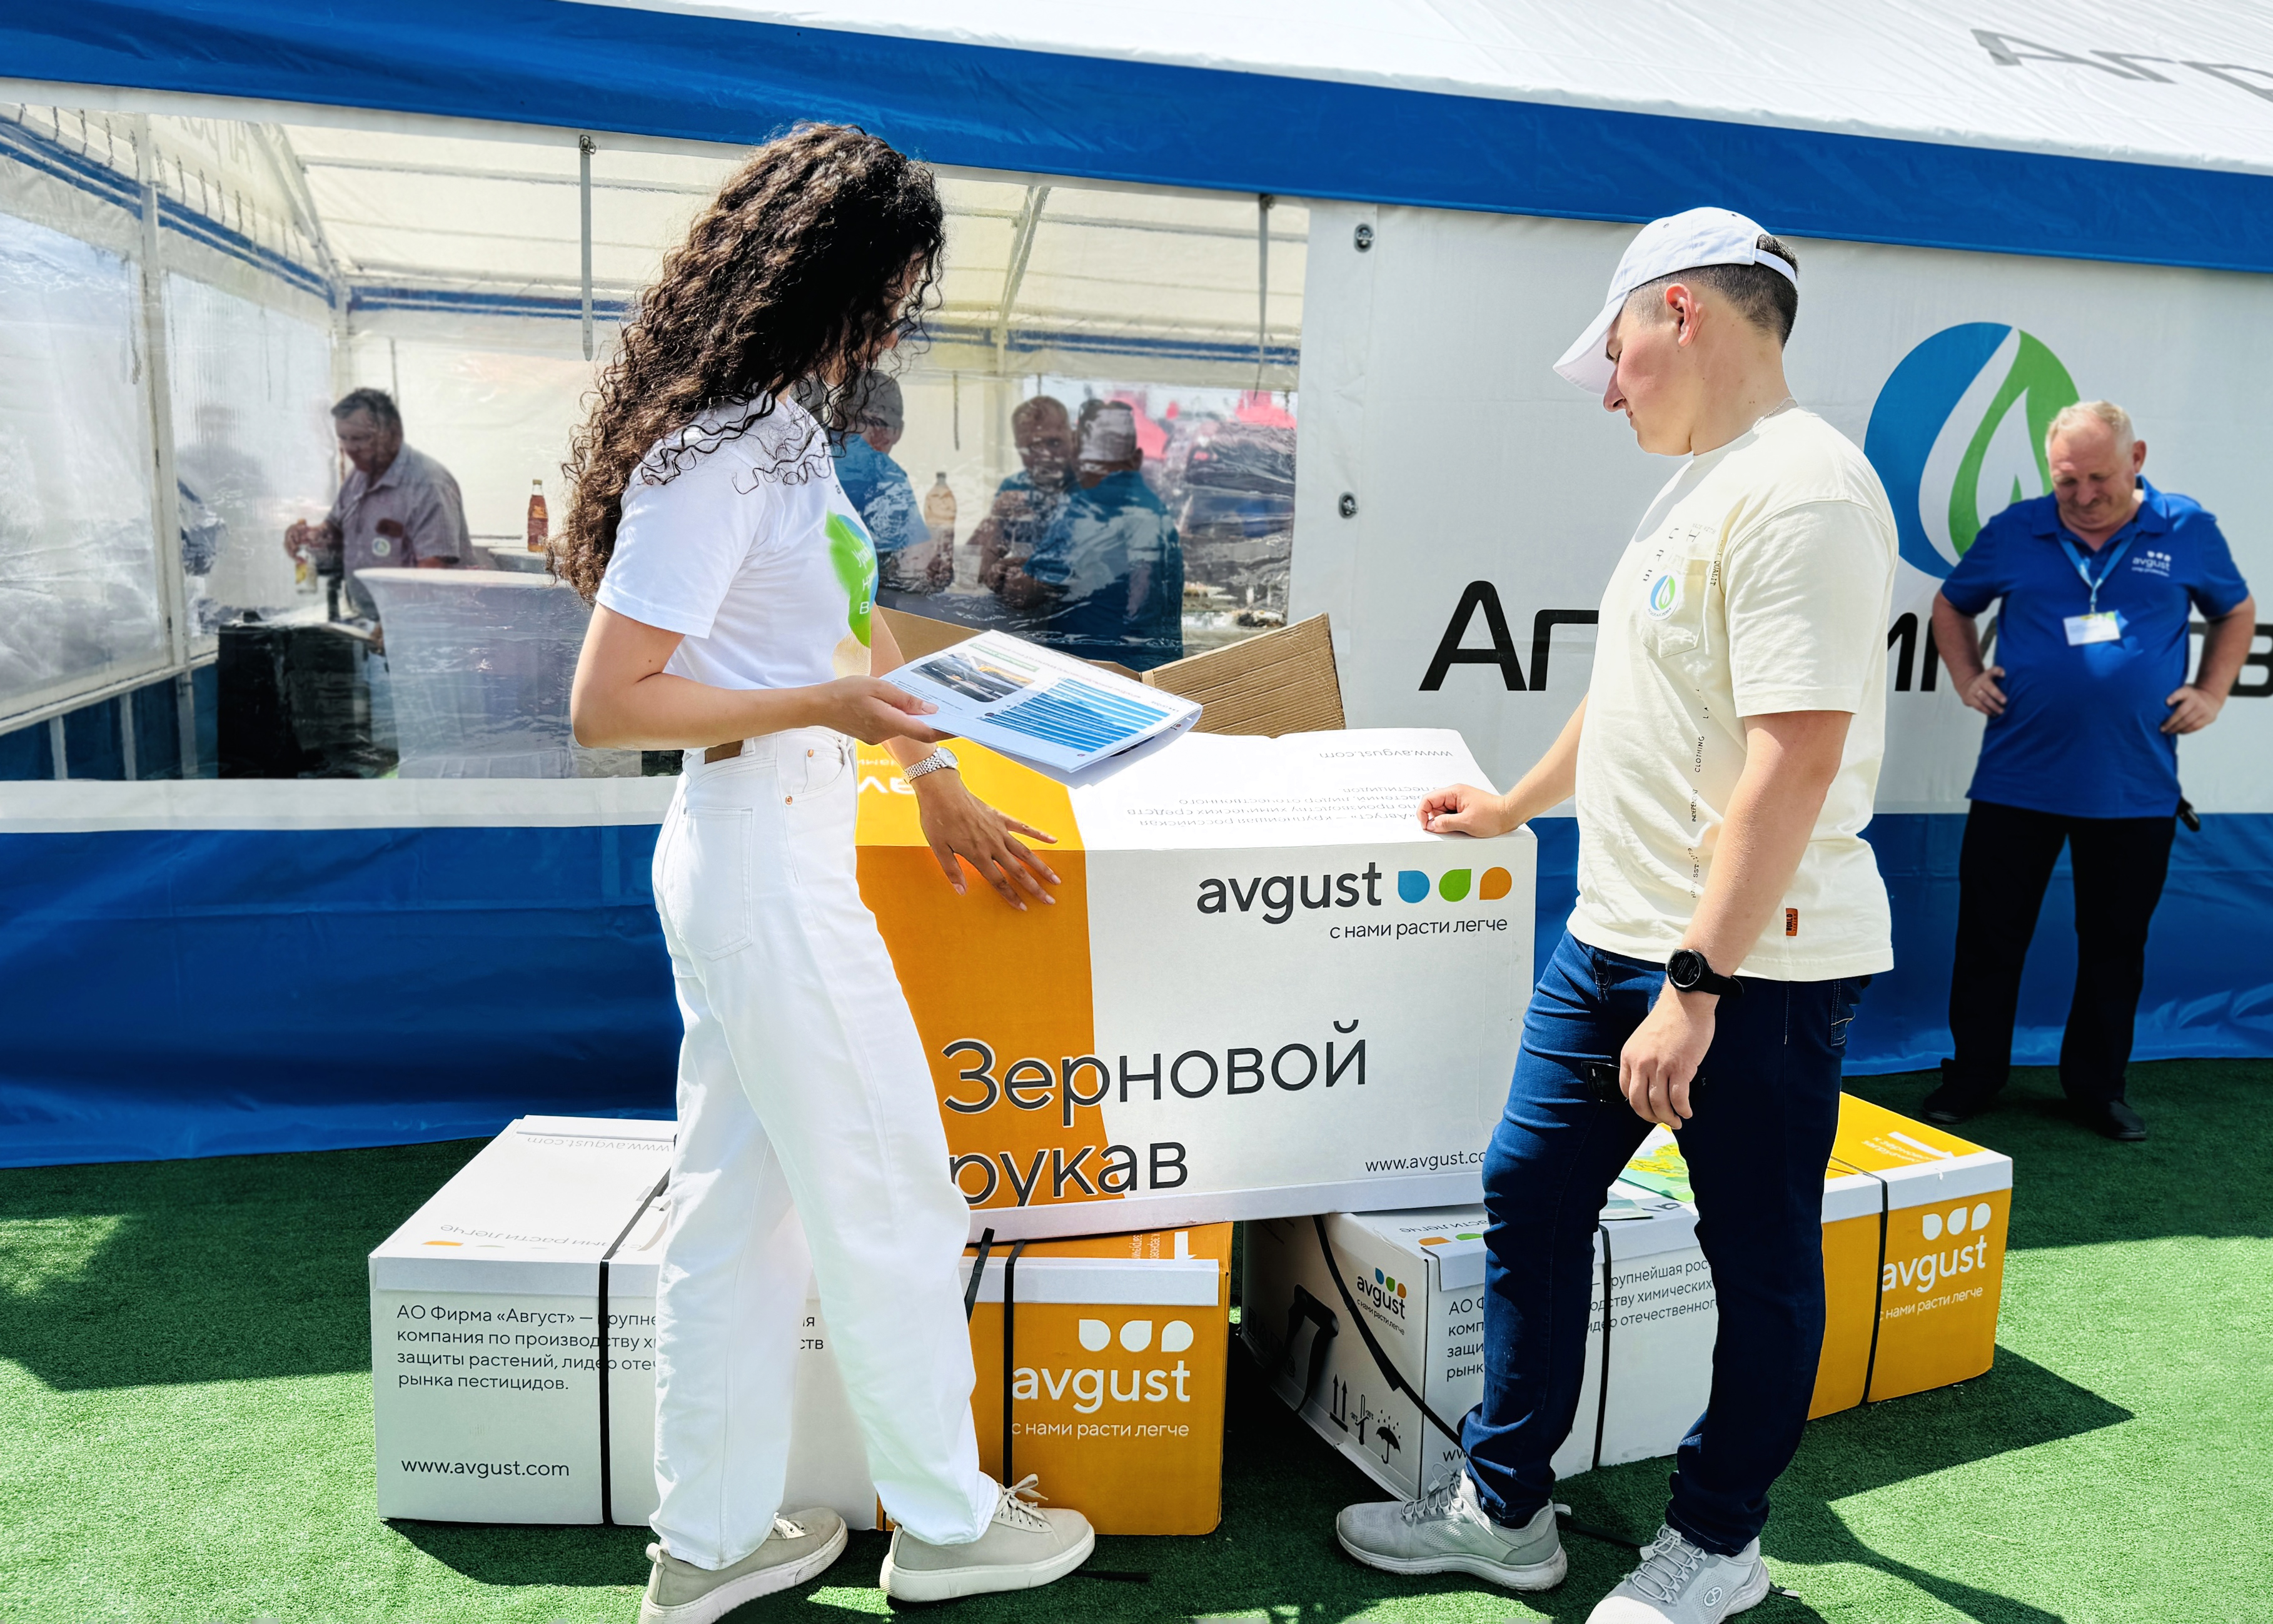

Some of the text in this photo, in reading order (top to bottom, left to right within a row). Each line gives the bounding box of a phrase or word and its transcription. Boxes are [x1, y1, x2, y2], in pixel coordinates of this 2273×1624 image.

[2132, 557, 2170, 572] avgust
[1319, 749, 1453, 759] www.avgust.com
[1695, 736, 1705, 772] CLOTHING
[1197, 862, 1382, 924] avgust
[1329, 918, 1508, 939] с нами расти легче
[942, 1019, 1366, 1127] Зерновой
[527, 1137, 670, 1152] www.avgust.com
[1366, 1151, 1486, 1173] www.avgust.co
[949, 1141, 1188, 1207] рукав
[440, 1224, 505, 1239] легче
[1399, 1219, 1489, 1233] асти легче
[505, 1235, 569, 1246] расти
[1882, 1235, 1987, 1293] avgust
[1611, 1266, 1682, 1290] рупнейшая
[1357, 1276, 1405, 1319] avgust
[1637, 1279, 1713, 1303] химических
[1449, 1299, 1473, 1315] АО
[1621, 1299, 1715, 1326] отечественног
[1885, 1303, 1915, 1319] нами
[1917, 1294, 1950, 1314] расти
[1952, 1287, 1983, 1303] легче
[397, 1304, 425, 1319] АО
[431, 1305, 491, 1324] Фирма
[497, 1308, 575, 1326] «Август»
[1449, 1321, 1484, 1336] комп
[398, 1331, 483, 1344] компания
[489, 1334, 510, 1344] по
[515, 1334, 640, 1351] производтву
[1447, 1343, 1484, 1358] защи
[397, 1353, 464, 1366] защиты
[470, 1354, 558, 1369] растений,
[399, 1374, 568, 1391] рынка пестицидов.
[1447, 1363, 1484, 1382] рынк
[1012, 1360, 1191, 1413] avgust
[1026, 1423, 1072, 1436] нами
[1077, 1423, 1131, 1440] расти
[1135, 1425, 1189, 1436] легче
[401, 1460, 569, 1478] www.avgust.com
